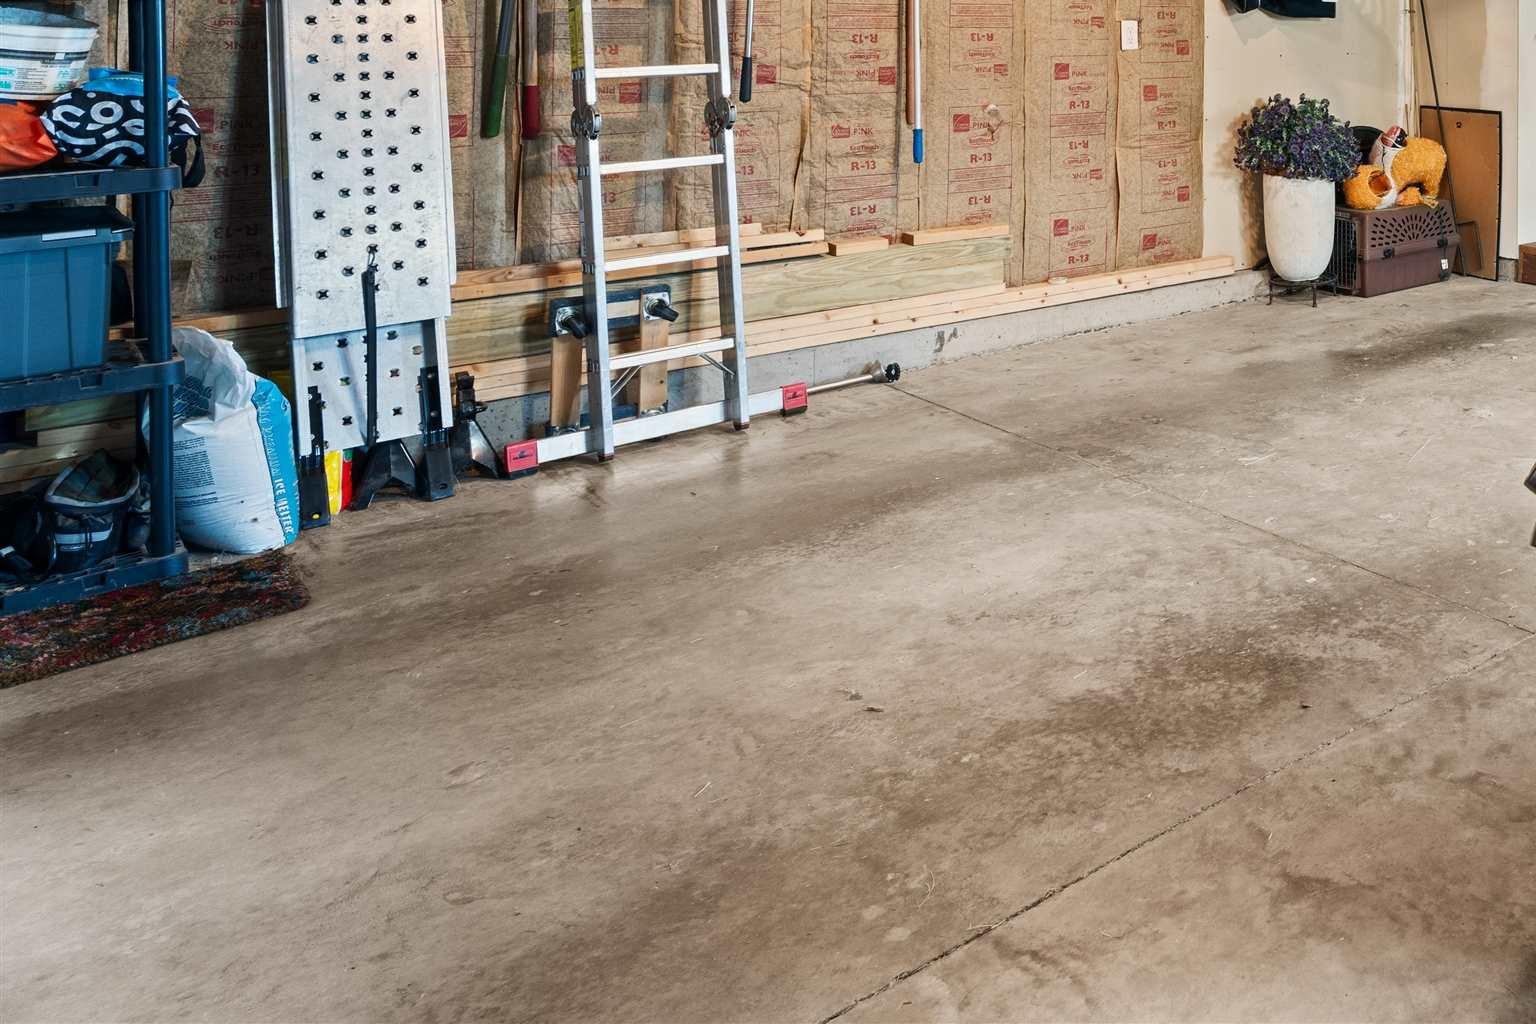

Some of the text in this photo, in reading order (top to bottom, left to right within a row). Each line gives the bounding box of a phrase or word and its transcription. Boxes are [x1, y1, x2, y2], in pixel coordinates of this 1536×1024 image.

[851, 33, 878, 44] R-13
[970, 32, 994, 43] R-13
[1069, 99, 1091, 110] R-13
[1158, 120, 1176, 130] R-13
[1069, 139, 1089, 150] R-13
[970, 152, 993, 164] R-13
[1158, 158, 1177, 168] R-13
[851, 160, 877, 171] R-13
[968, 194, 992, 206] R-13
[850, 204, 877, 216] R-13
[1068, 254, 1090, 265] R-13
[274, 477, 287, 495] ICE
